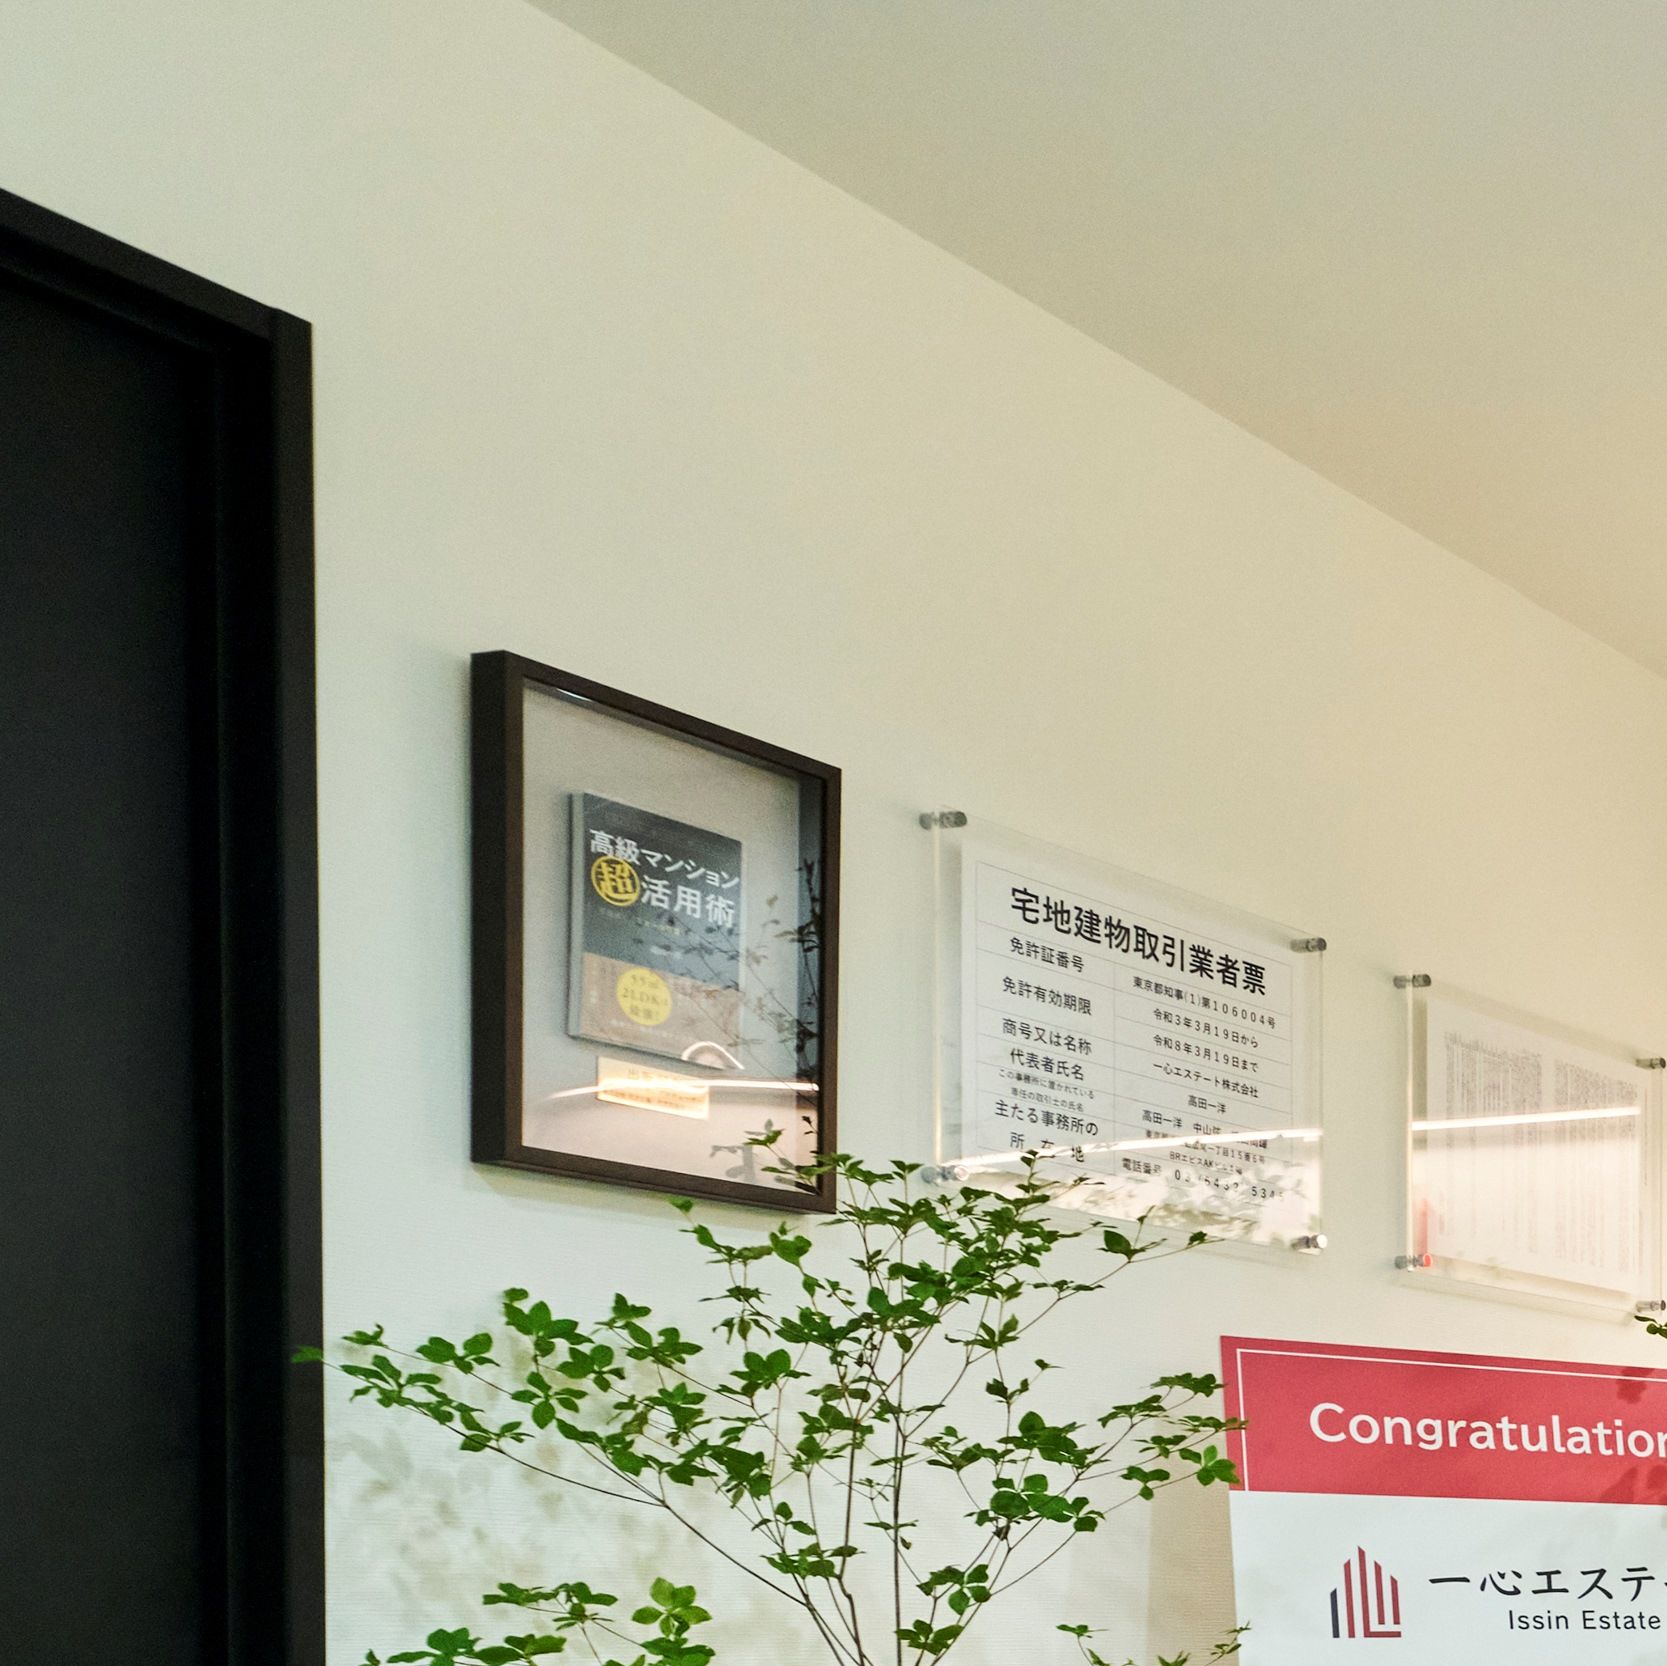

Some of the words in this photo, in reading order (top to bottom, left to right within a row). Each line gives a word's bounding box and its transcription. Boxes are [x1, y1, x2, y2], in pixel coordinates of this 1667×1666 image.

[589, 829, 740, 889] 高級マンション
[1010, 937, 1085, 973] 免許証番号
[1011, 887, 1267, 996] 宅地建物取引業者票
[1002, 976, 1093, 1017] 免許有効期限
[1002, 1017, 1093, 1057] 商号又は名称
[1153, 1008, 1259, 1049] 令和3年3月19日から
[1009, 1048, 1085, 1081] 代表者氏名
[1153, 1034, 1259, 1073] 令和8年3月19日まで
[1152, 1062, 1259, 1099] 一心エステート株式会社
[995, 1099, 1099, 1136] 主たる事務所の
[1142, 1109, 1183, 1129] 高田一洋
[1188, 1094, 1227, 1115] 高田一洋
[1508, 1610, 1570, 1631] Issin
[1582, 1609, 1662, 1631] Estate
